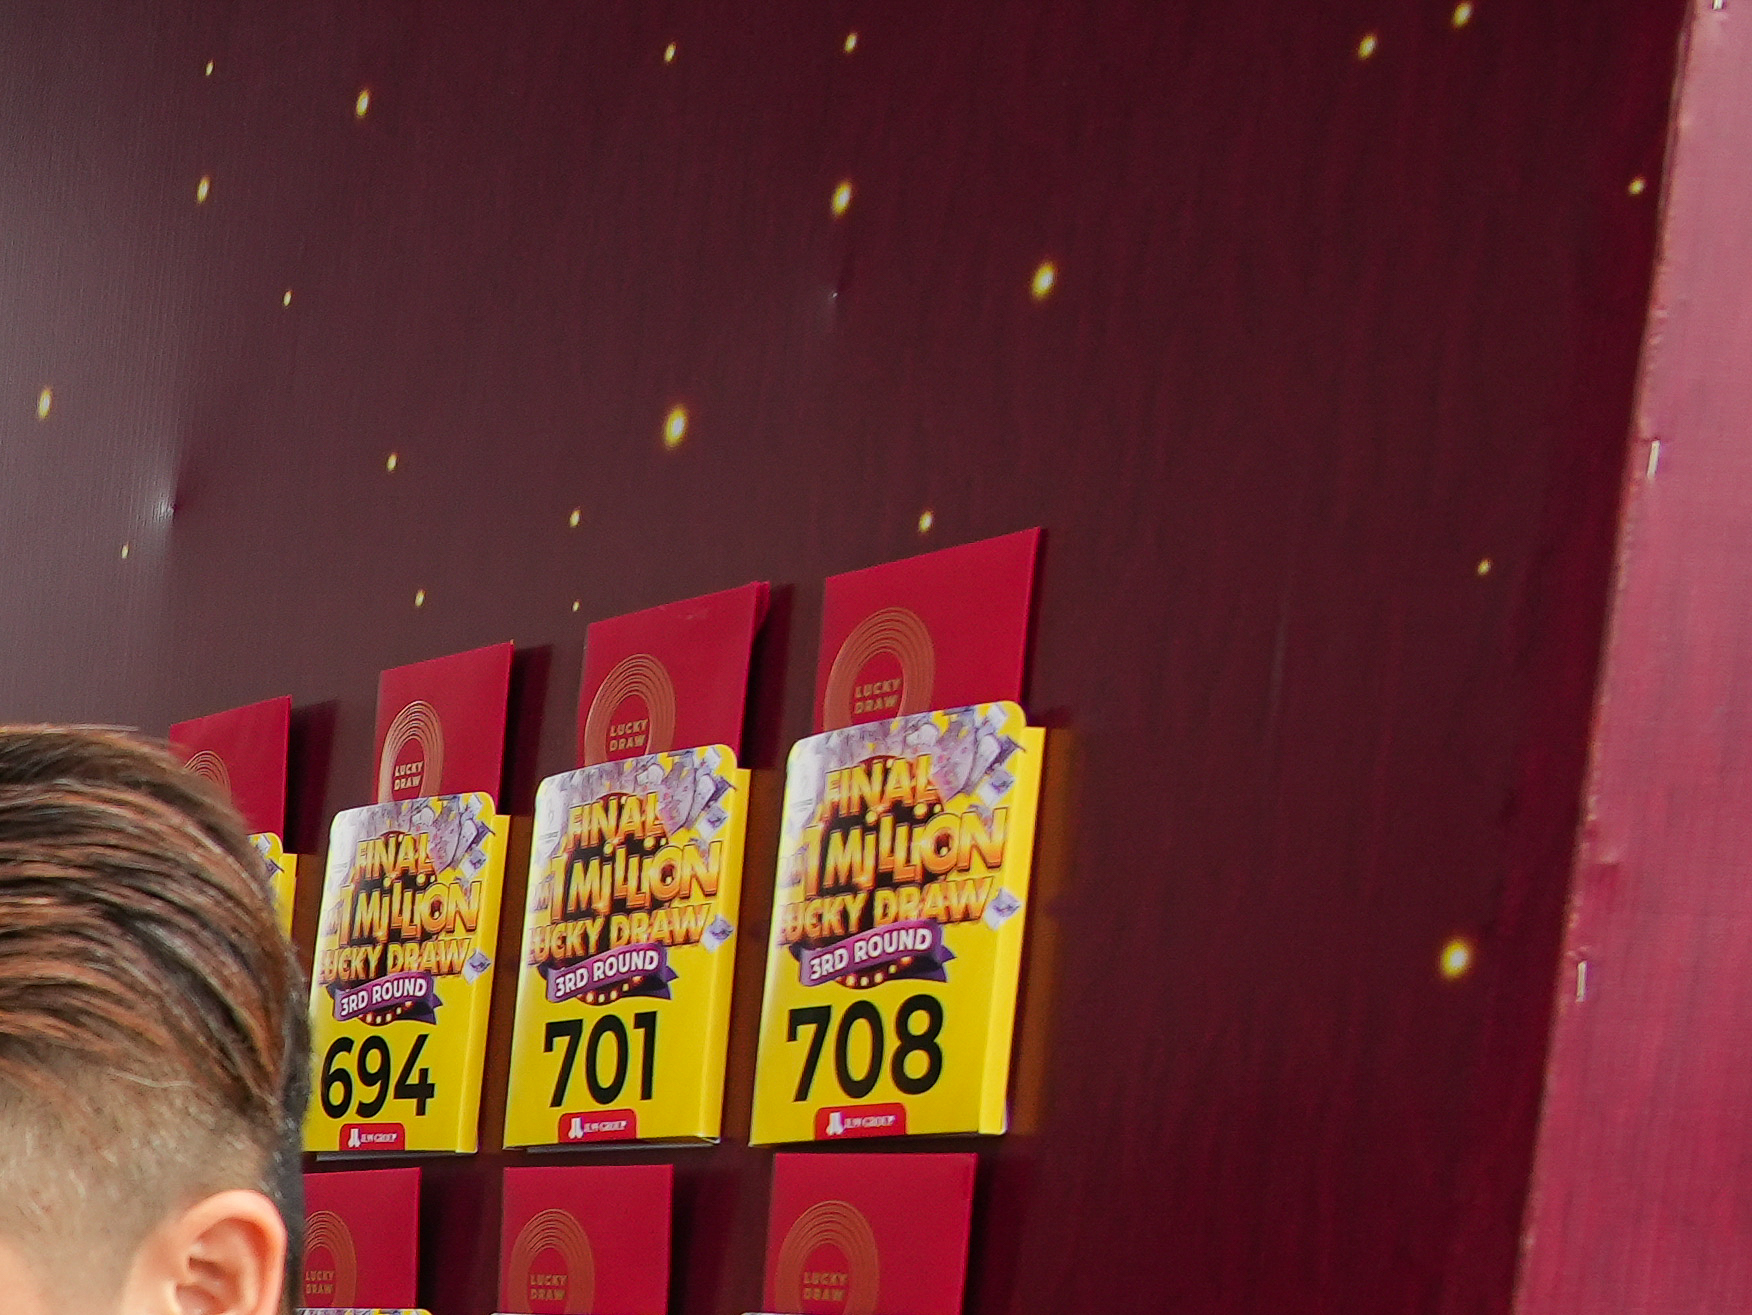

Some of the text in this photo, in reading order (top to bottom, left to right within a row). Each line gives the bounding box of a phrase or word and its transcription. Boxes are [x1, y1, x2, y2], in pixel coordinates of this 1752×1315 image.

[824, 754, 940, 819] FINAL
[567, 792, 666, 849] FINAL
[823, 804, 1009, 890] MILLION
[356, 832, 435, 879] FINAL
[567, 836, 722, 914] MILLION
[355, 876, 482, 942] MILLION
[610, 903, 712, 949] DRAW
[873, 876, 994, 926] DRAW
[386, 938, 471, 976] DRAW
[555, 950, 659, 997] 3RD ROUND
[809, 929, 932, 980] 3RD ROUND
[341, 977, 428, 1016] 3RD ROUND
[320, 1033, 435, 1119] 694
[544, 1011, 657, 1107] 701
[787, 994, 943, 1102] 708
